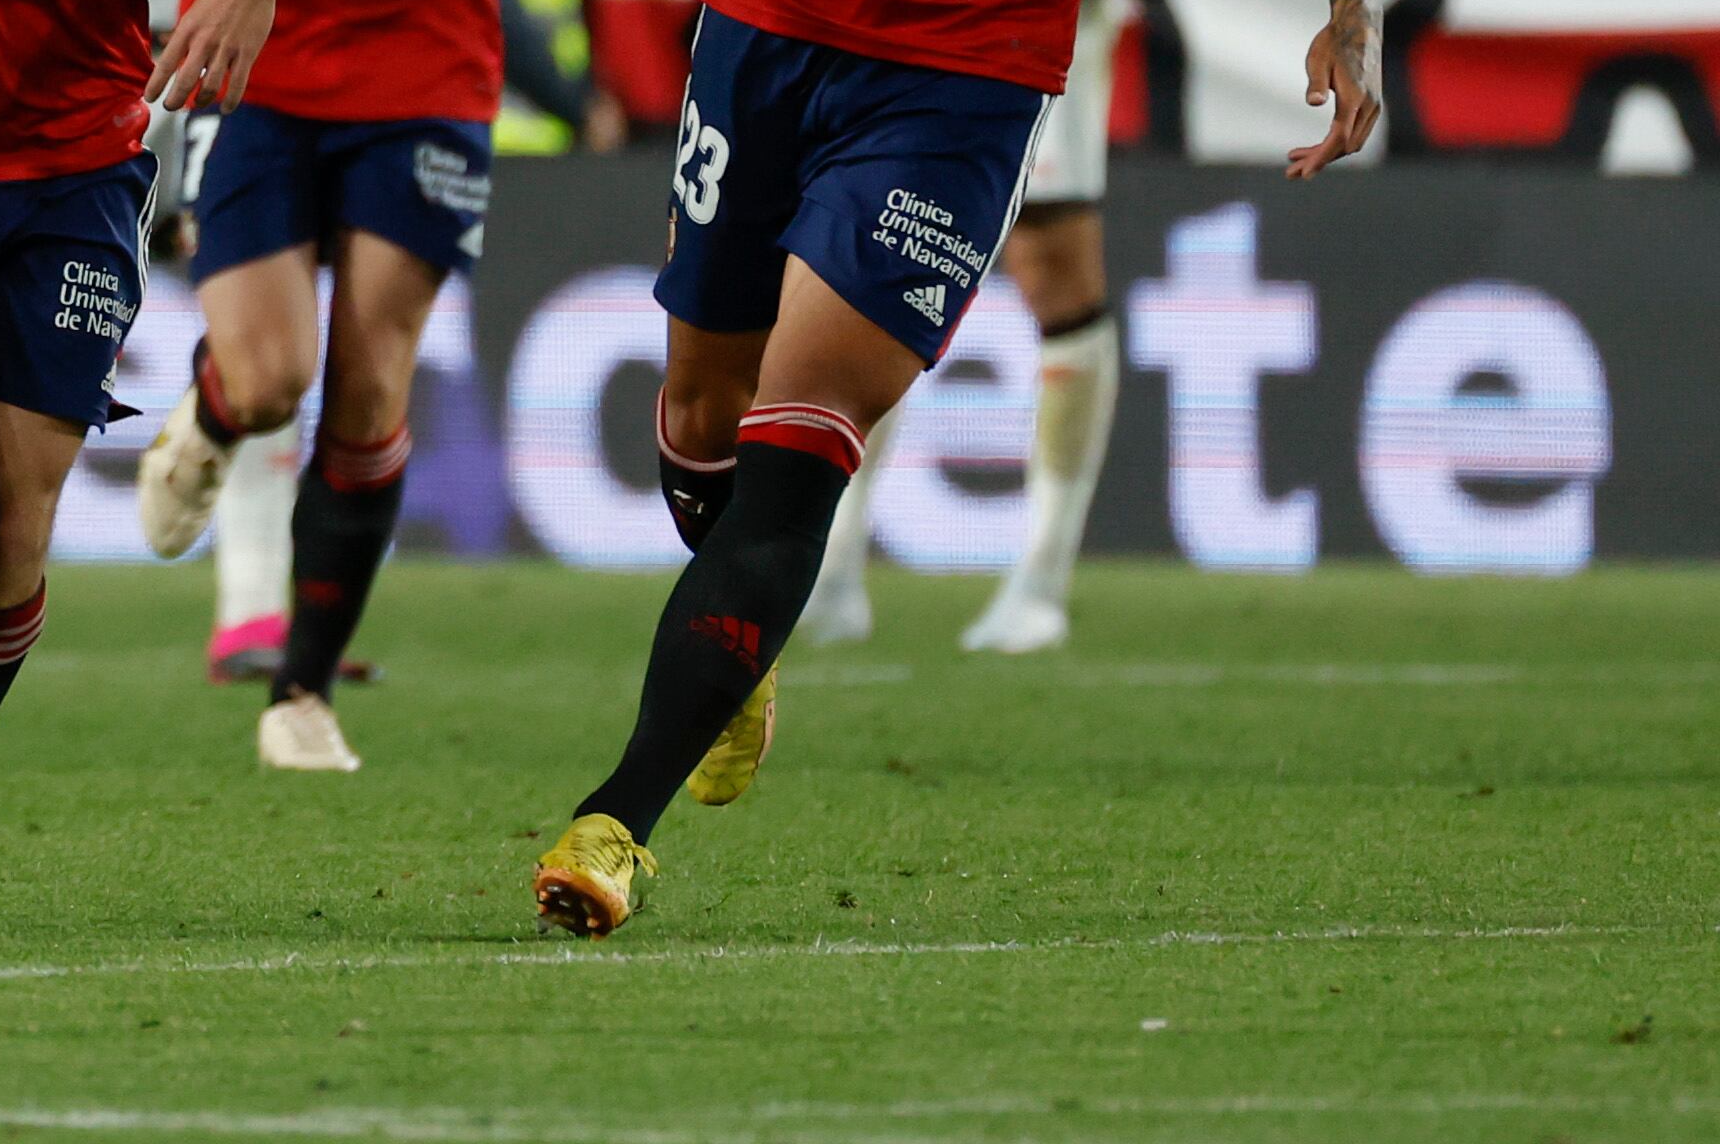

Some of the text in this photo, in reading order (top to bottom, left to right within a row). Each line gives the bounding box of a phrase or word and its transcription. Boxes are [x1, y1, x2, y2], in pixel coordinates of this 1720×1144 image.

[672, 99, 730, 225] 23
[886, 188, 954, 228] Clínica
[872, 228, 972, 289] de Navarra
[878, 208, 988, 273] Universidad
[63, 261, 119, 292] Clínica
[54, 307, 82, 331] de
[902, 291, 945, 327] adidas
